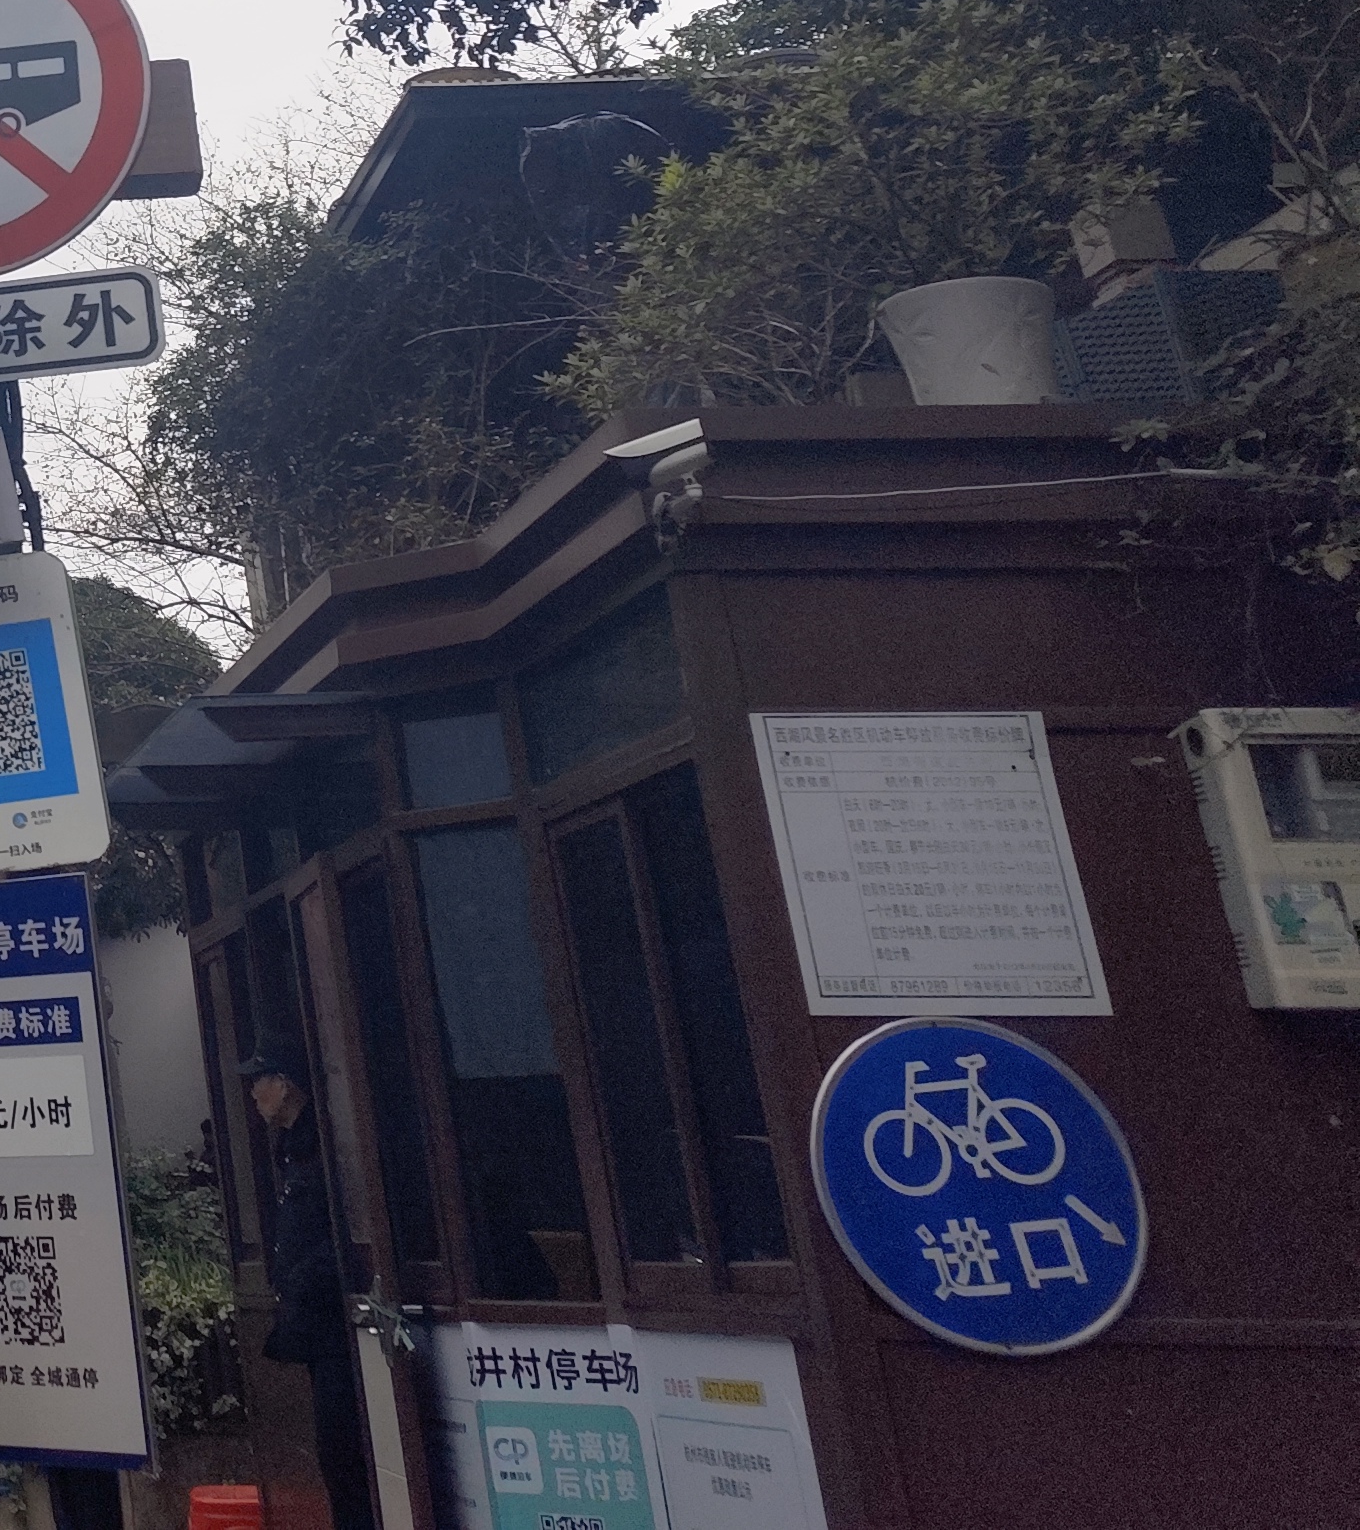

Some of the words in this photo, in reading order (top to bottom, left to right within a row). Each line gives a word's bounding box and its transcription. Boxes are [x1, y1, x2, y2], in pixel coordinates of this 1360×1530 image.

[913, 1216, 1089, 1301] 进口
[547, 1427, 633, 1467] 先离场
[554, 1466, 639, 1503] 后付费
